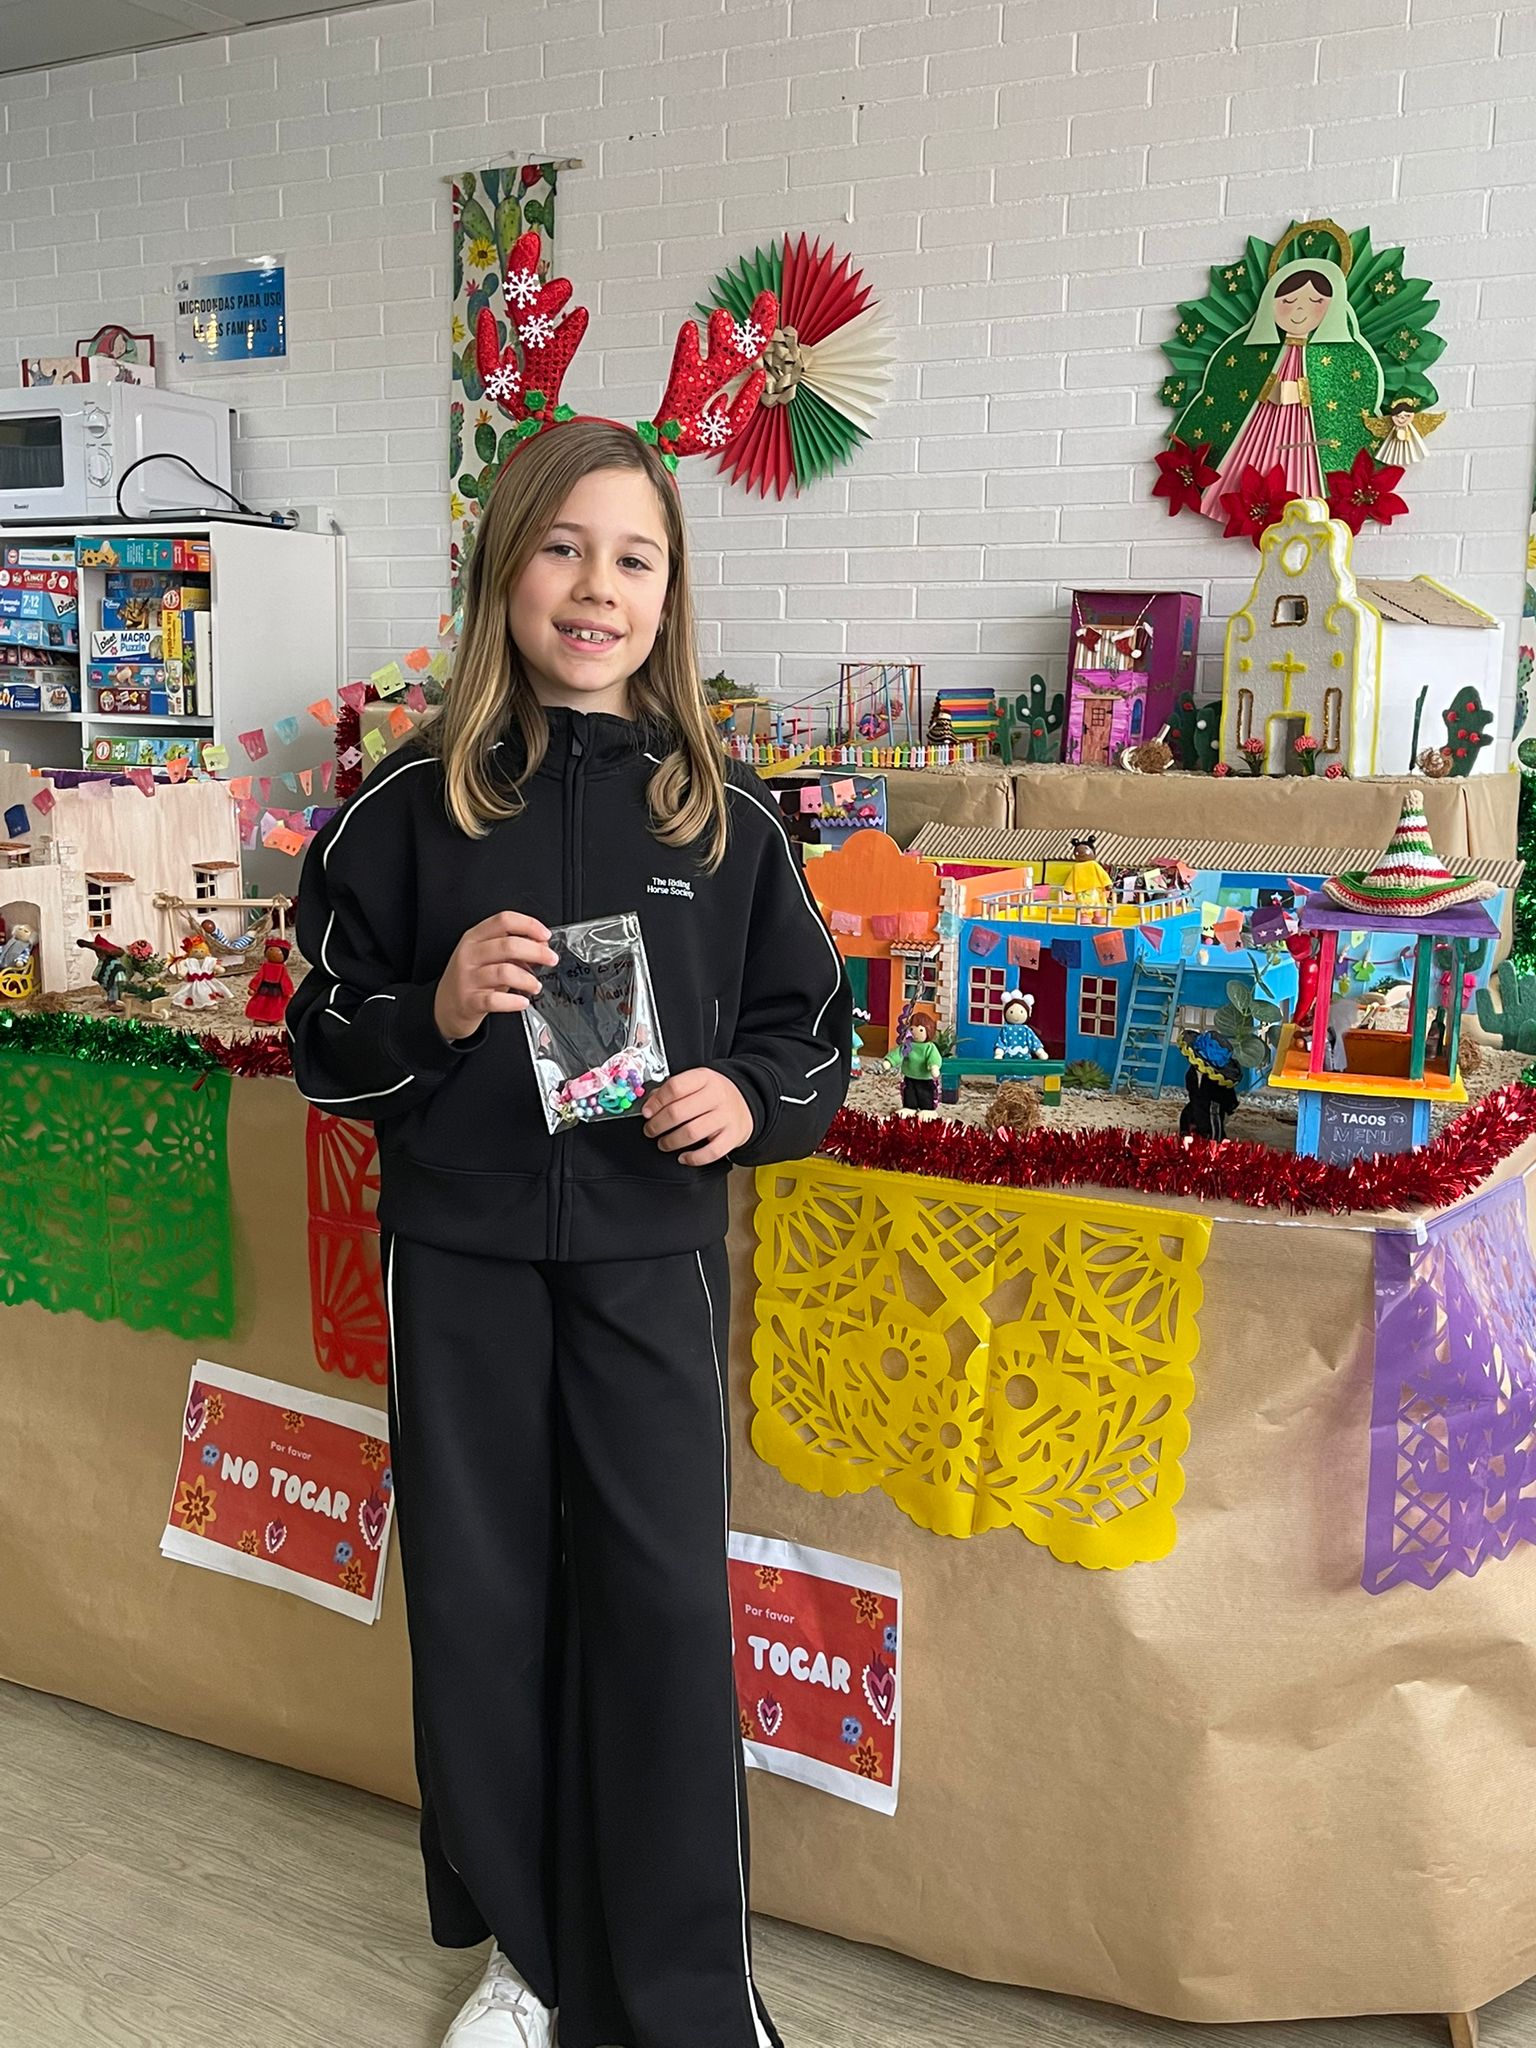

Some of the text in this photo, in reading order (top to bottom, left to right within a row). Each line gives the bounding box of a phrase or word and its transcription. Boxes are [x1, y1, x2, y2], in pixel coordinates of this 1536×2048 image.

[179, 291, 282, 315] MICROONDAS PARA USO
[99, 633, 117, 650] Diset
[120, 632, 151, 643] MACRO
[120, 642, 147, 652] Puzzle
[646, 884, 695, 900] Horse Society
[652, 876, 691, 891] The Riding
[1341, 1112, 1387, 1127] TACOS
[1333, 1126, 1394, 1146] MENU
[269, 1440, 312, 1461] Por favor
[220, 1451, 352, 1523] NO TOCAR
[744, 1603, 795, 1625] Por favor
[747, 1634, 852, 1695] TOCAR
